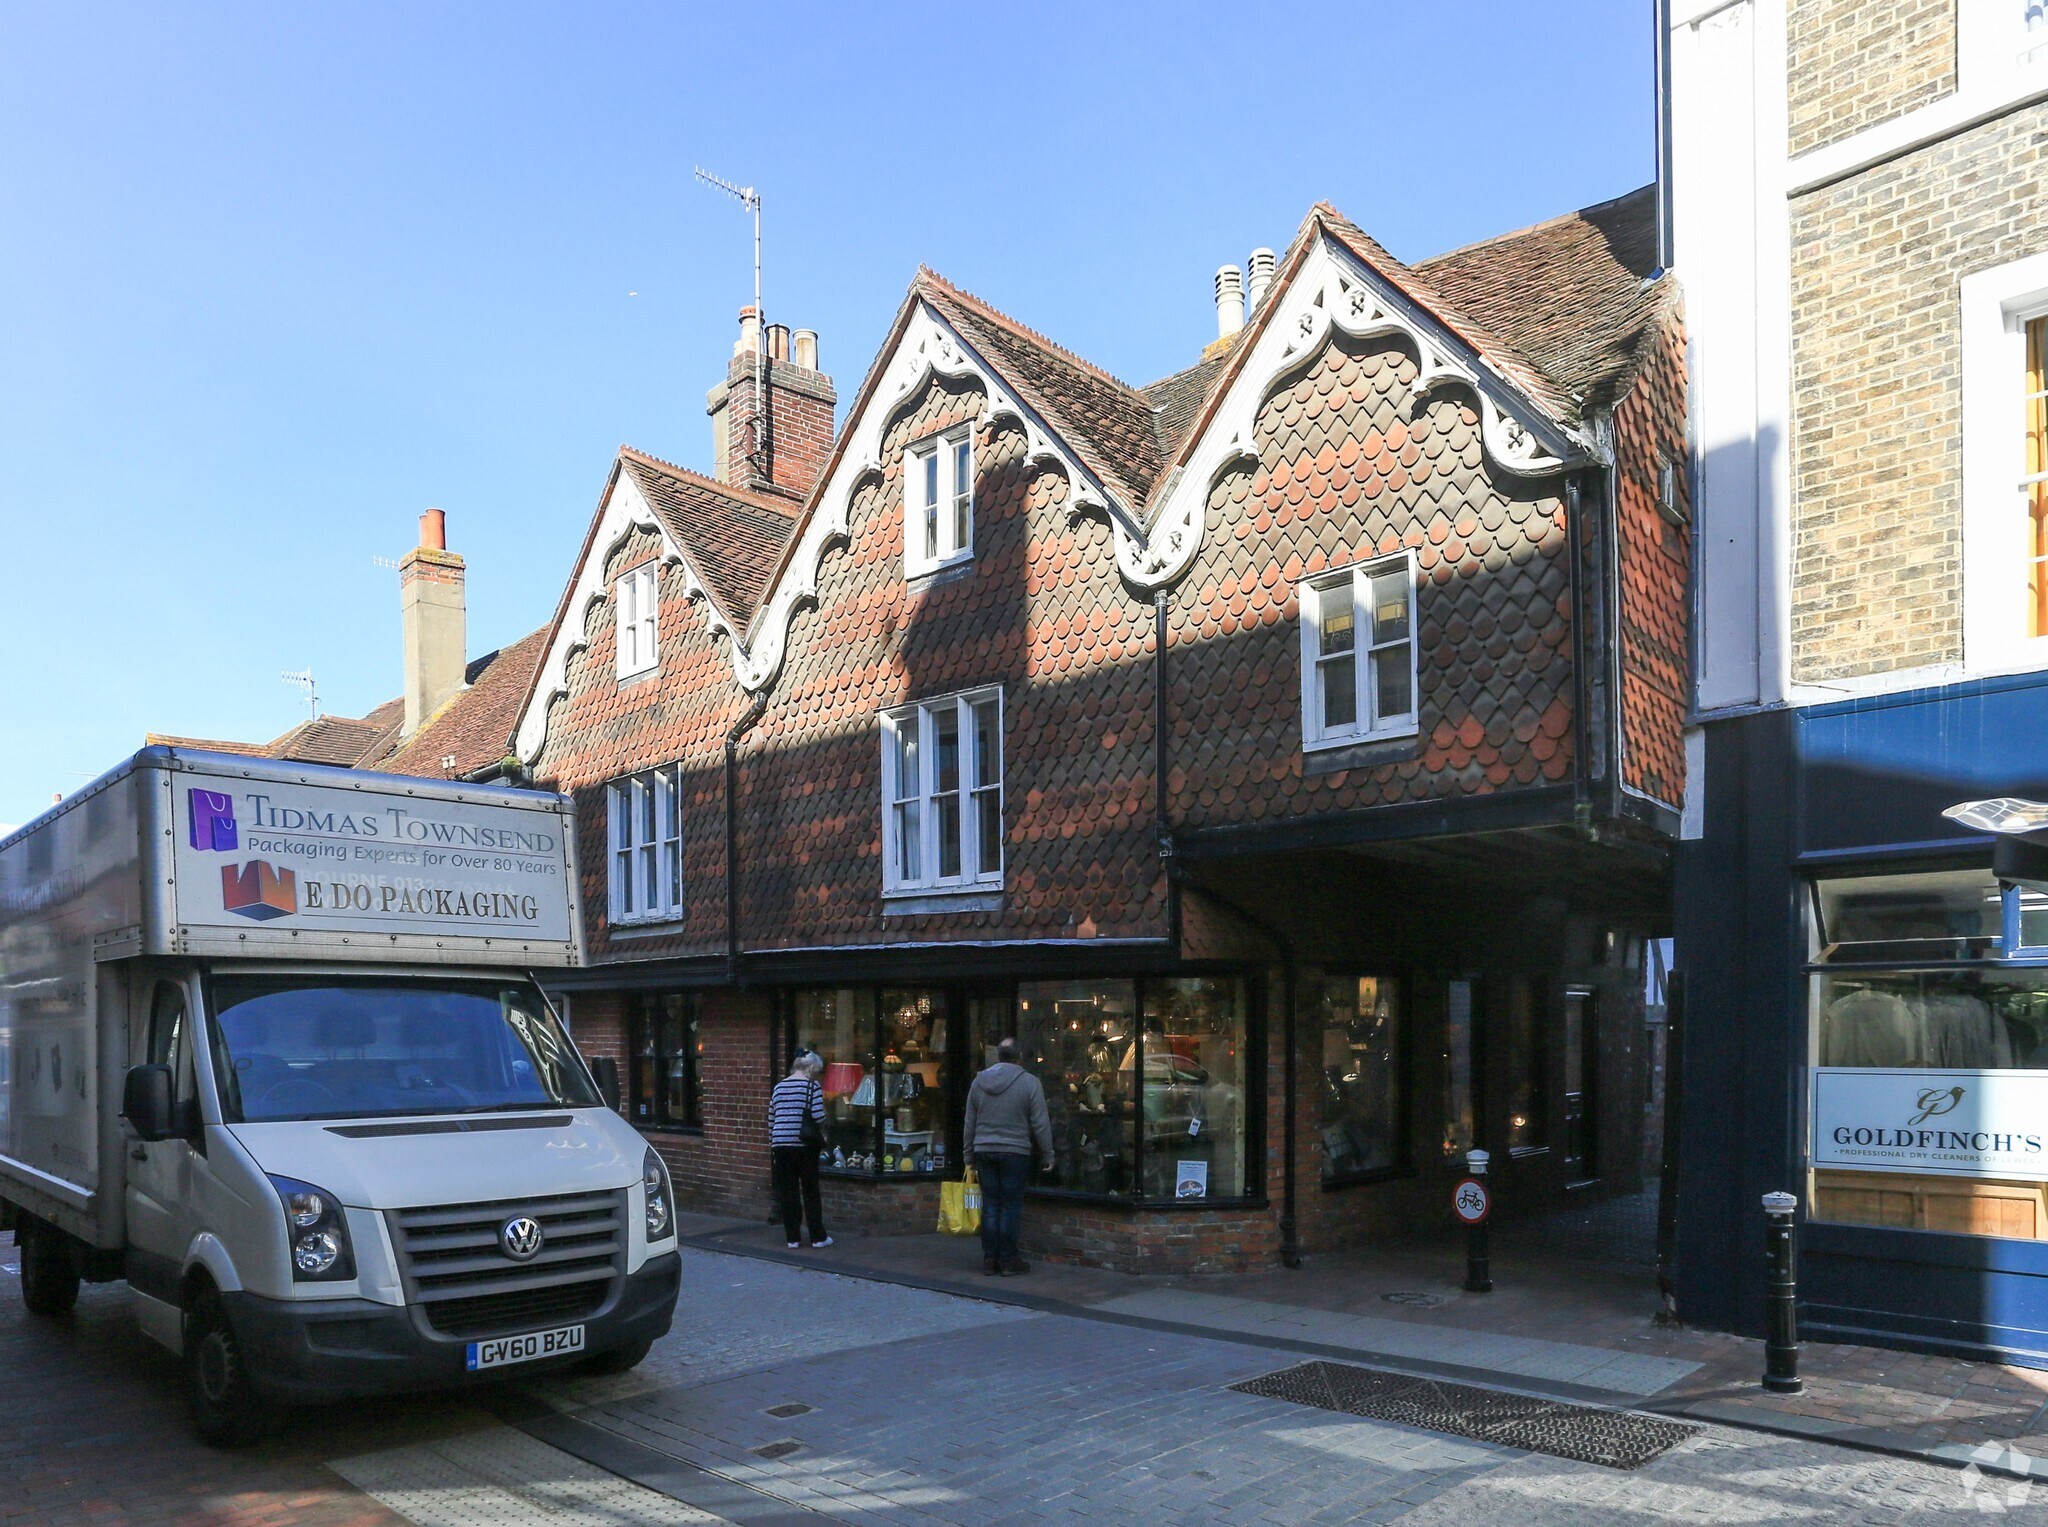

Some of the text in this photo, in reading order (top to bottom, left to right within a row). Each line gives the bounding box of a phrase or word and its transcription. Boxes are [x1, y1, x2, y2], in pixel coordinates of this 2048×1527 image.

[248, 837, 347, 861] Packaging
[355, 846, 417, 864] Experts
[423, 850, 446, 867] for
[451, 854, 489, 869] Over
[494, 859, 512, 871] 80
[516, 860, 557, 875] Years
[331, 882, 372, 912] DO
[379, 885, 539, 920] PACKAGING
[1833, 1126, 2042, 1154] GOLDFINCH'S
[1840, 1148, 1905, 1158] PROFESSIONAL
[1931, 1153, 1980, 1162] CLEANERS
[2001, 1156, 2035, 1165] LEWES
[481, 1327, 581, 1364] GV60 BZU
